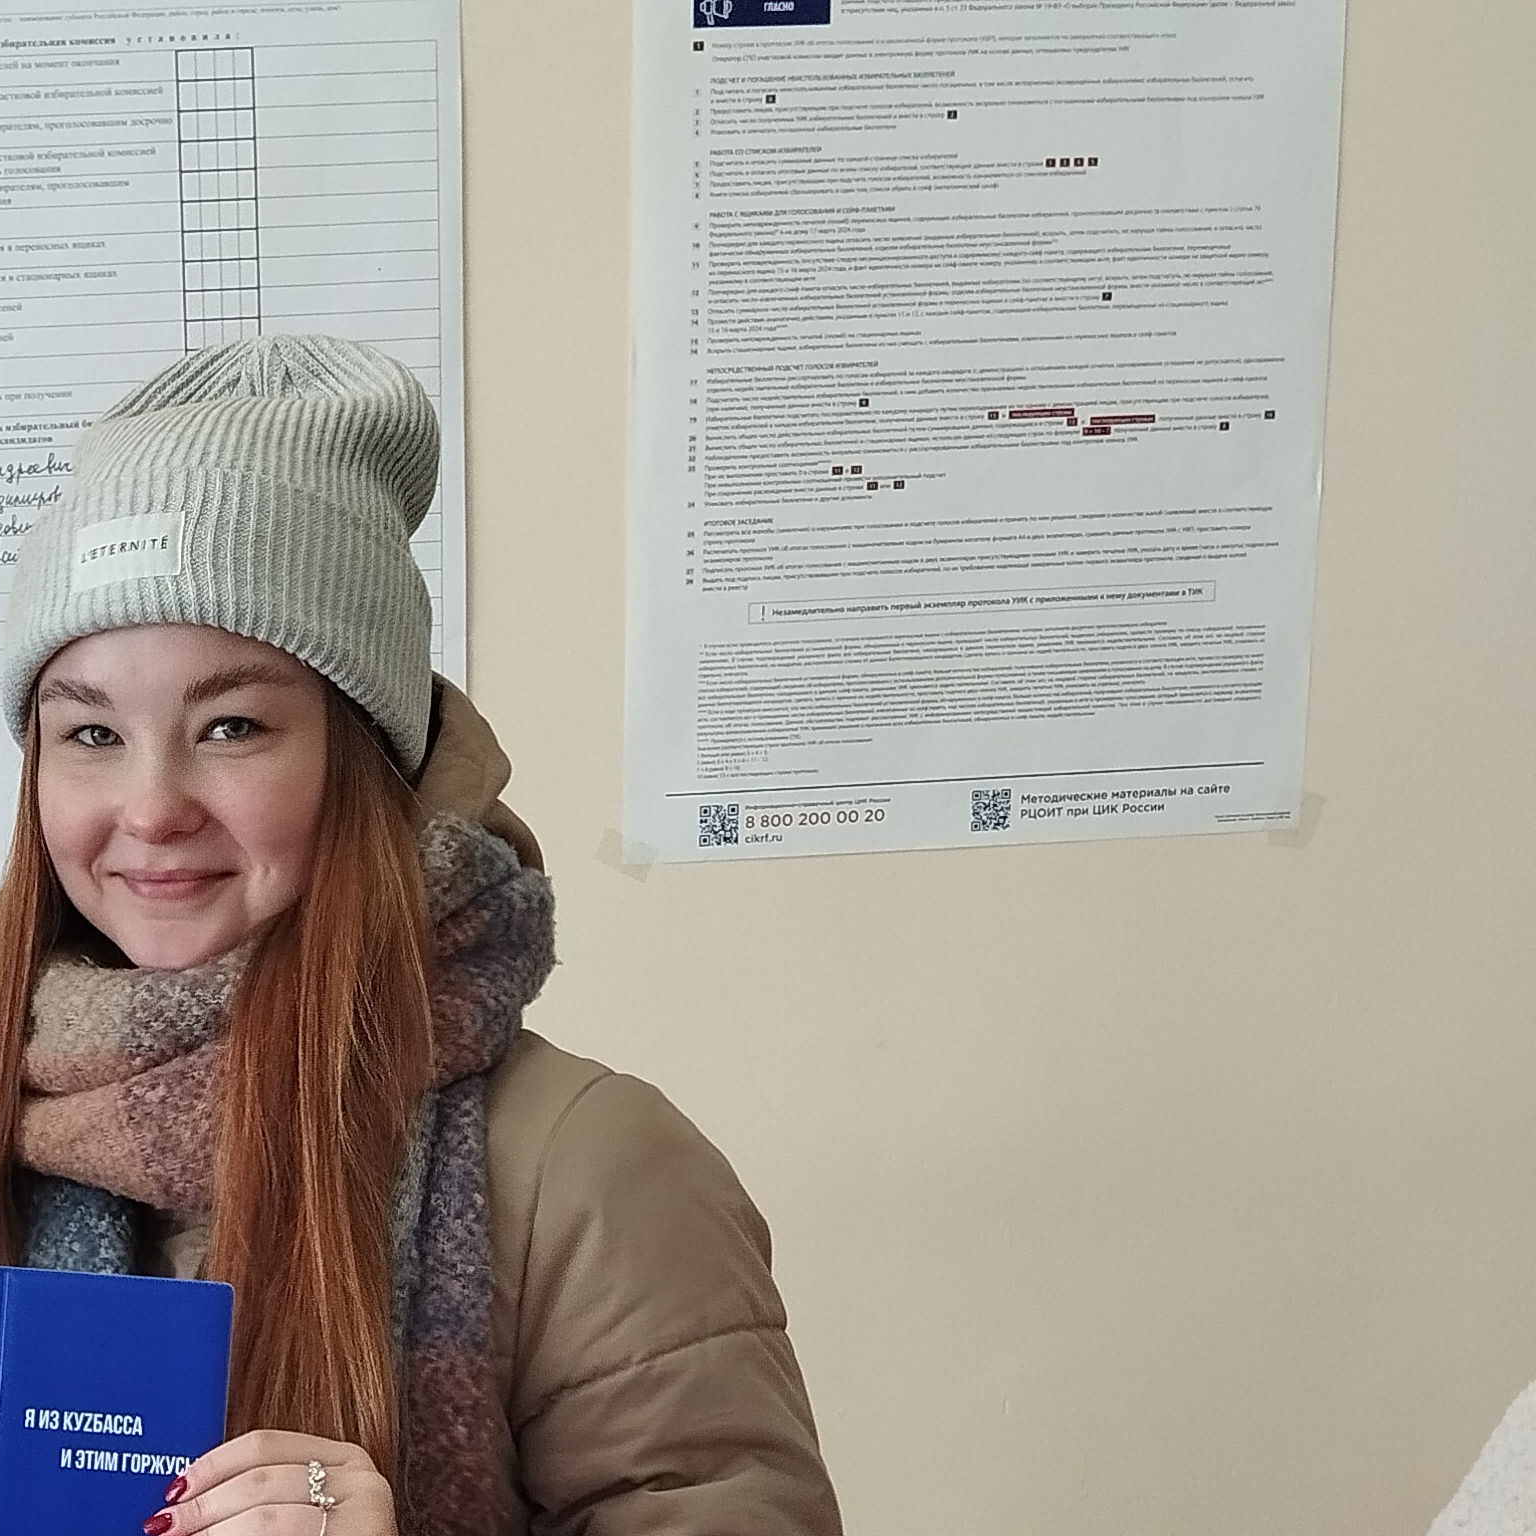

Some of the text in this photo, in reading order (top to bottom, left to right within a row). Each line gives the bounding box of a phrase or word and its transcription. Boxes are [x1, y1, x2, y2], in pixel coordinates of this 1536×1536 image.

[1020, 783, 1231, 805] Методические материалы на сайте
[745, 808, 885, 829] 8 800 200 00 20
[1020, 801, 1165, 821] РЦОИТ при ЦИК России
[744, 832, 783, 844] cikrf.ru
[24, 1408, 143, 1436] Я ИЗ КУZБАССА
[60, 1448, 72, 1469] И
[74, 1449, 118, 1472] ЭТИМ
